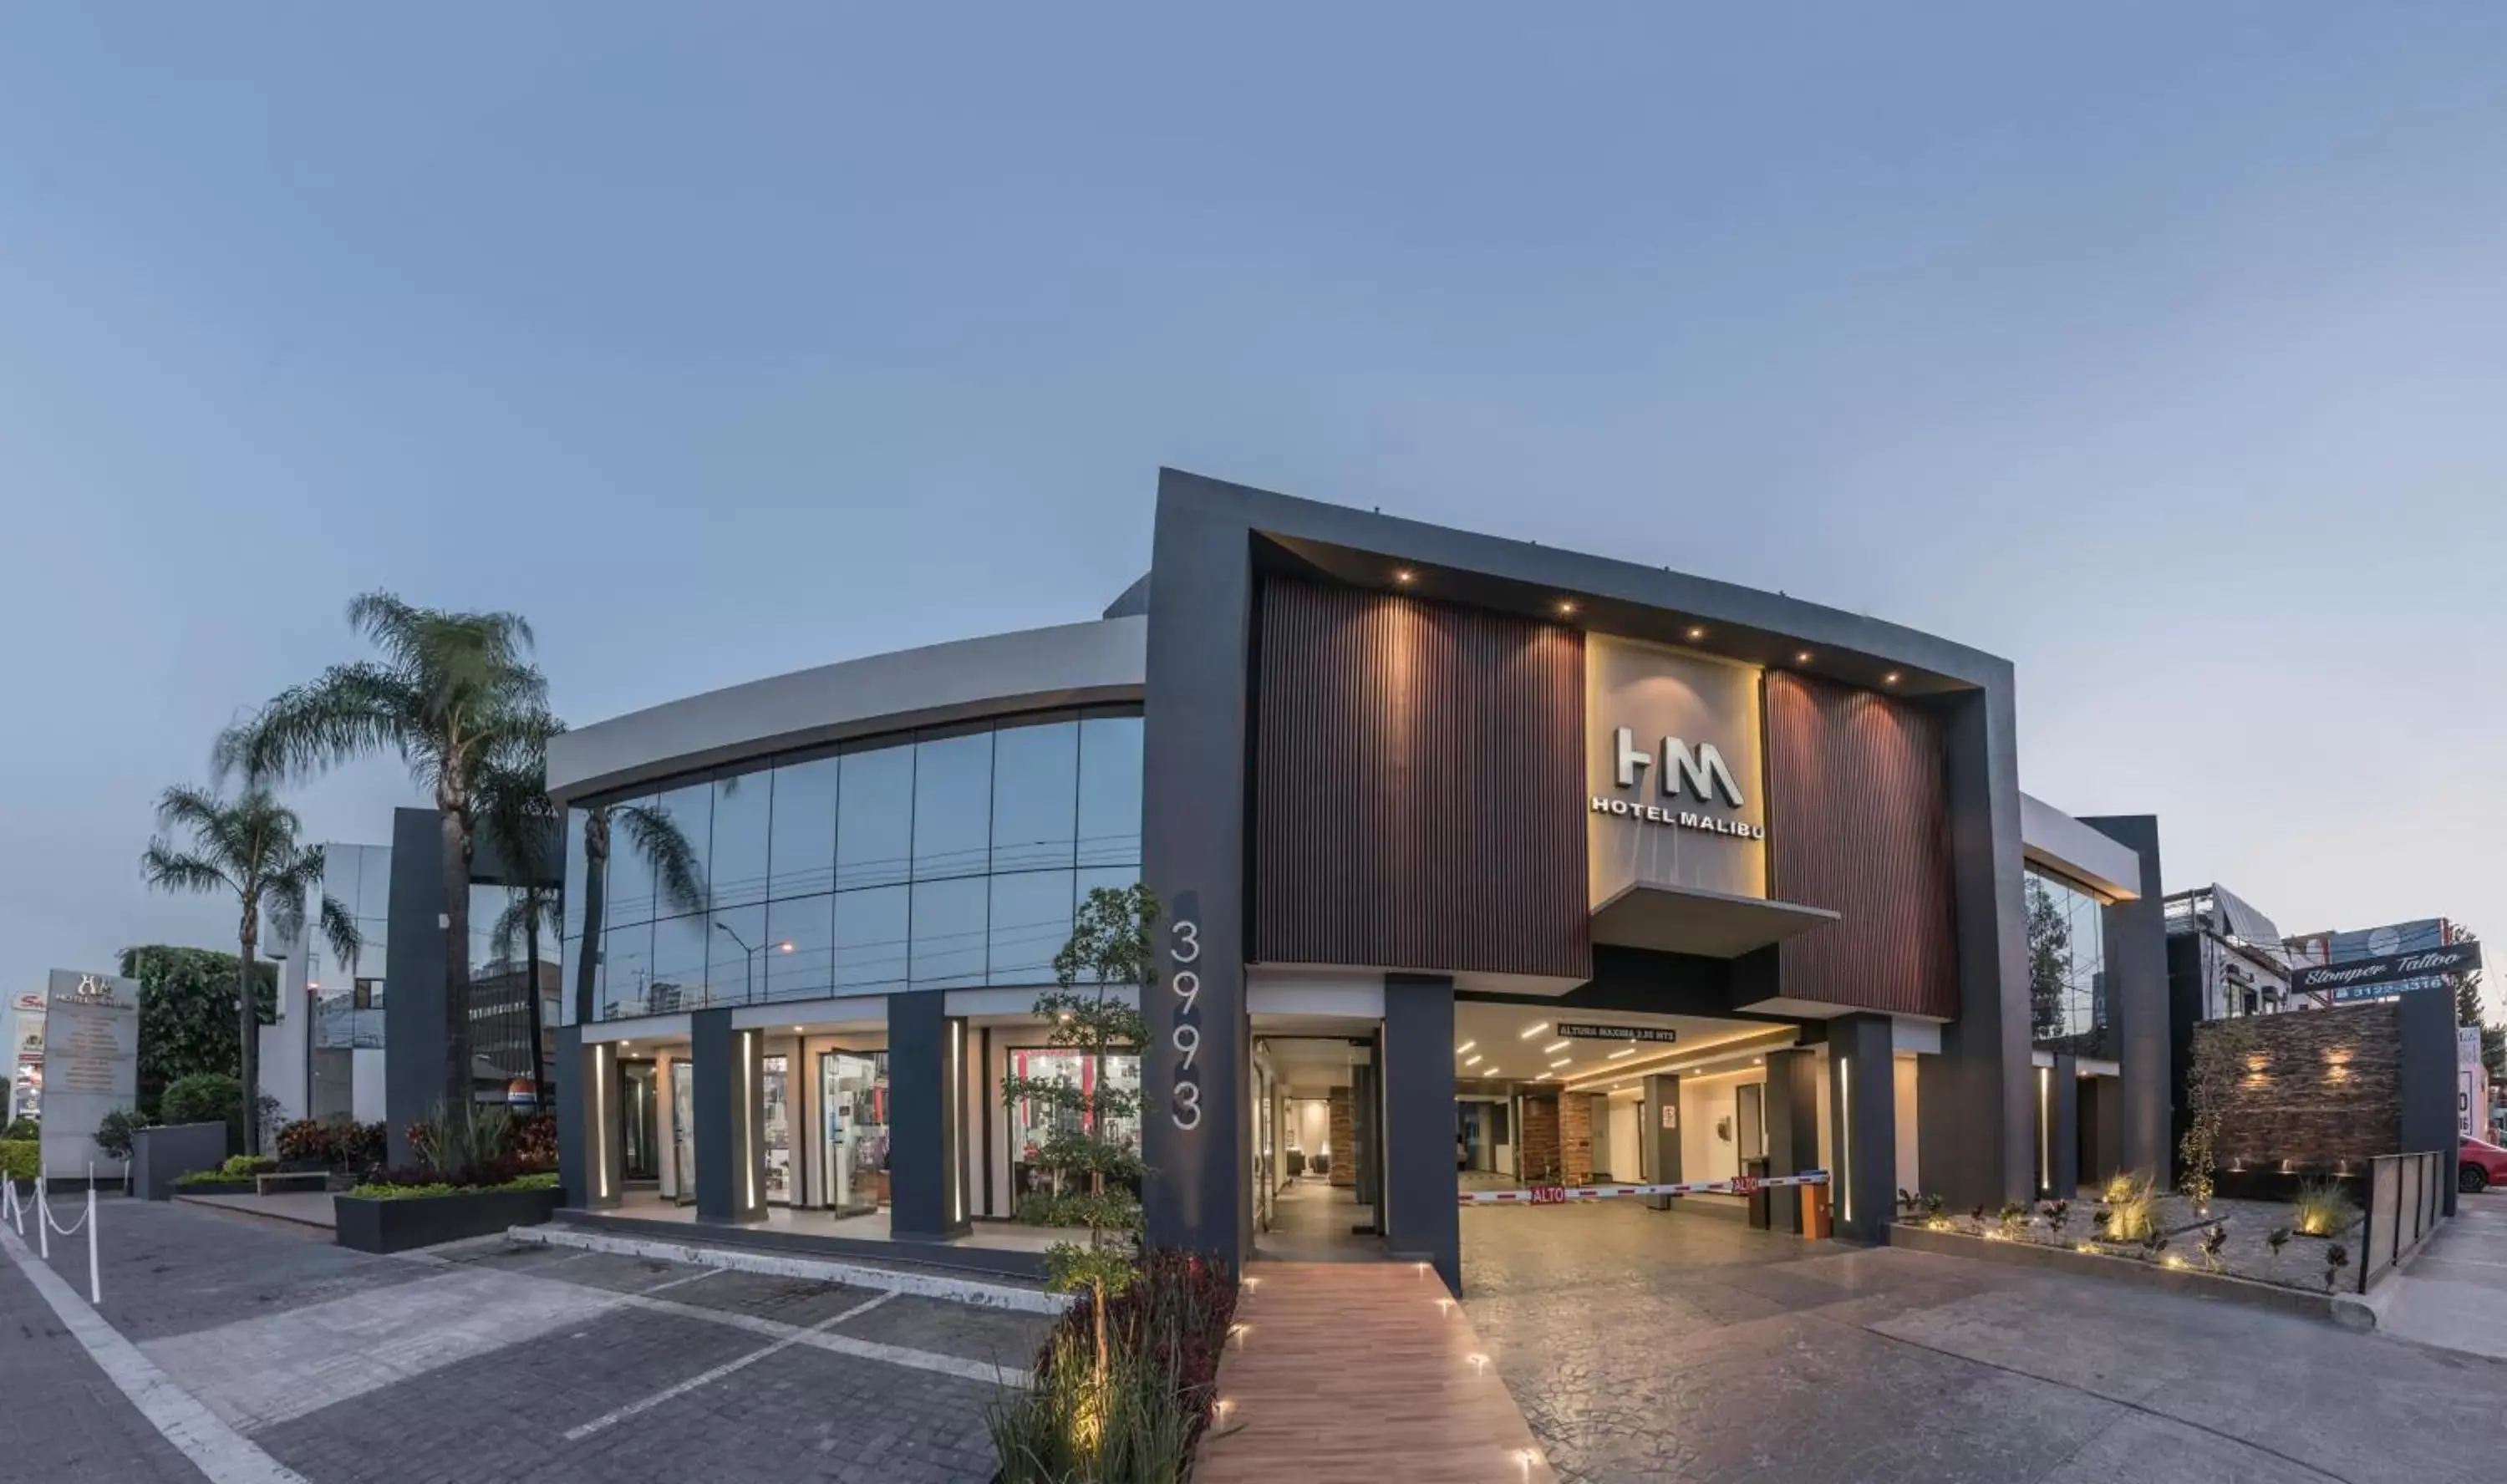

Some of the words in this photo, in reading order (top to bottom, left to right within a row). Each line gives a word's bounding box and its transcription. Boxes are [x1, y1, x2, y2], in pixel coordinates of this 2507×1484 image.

[1591, 795, 1675, 824] HOTEL
[1680, 811, 1766, 841] MALIBU
[2304, 963, 2387, 988] Stomper
[2397, 952, 2462, 973] Tattoo
[1171, 921, 1201, 1130] 3993
[1533, 1187, 1564, 1202] ALTO
[1734, 1177, 1759, 1192] ALTO
